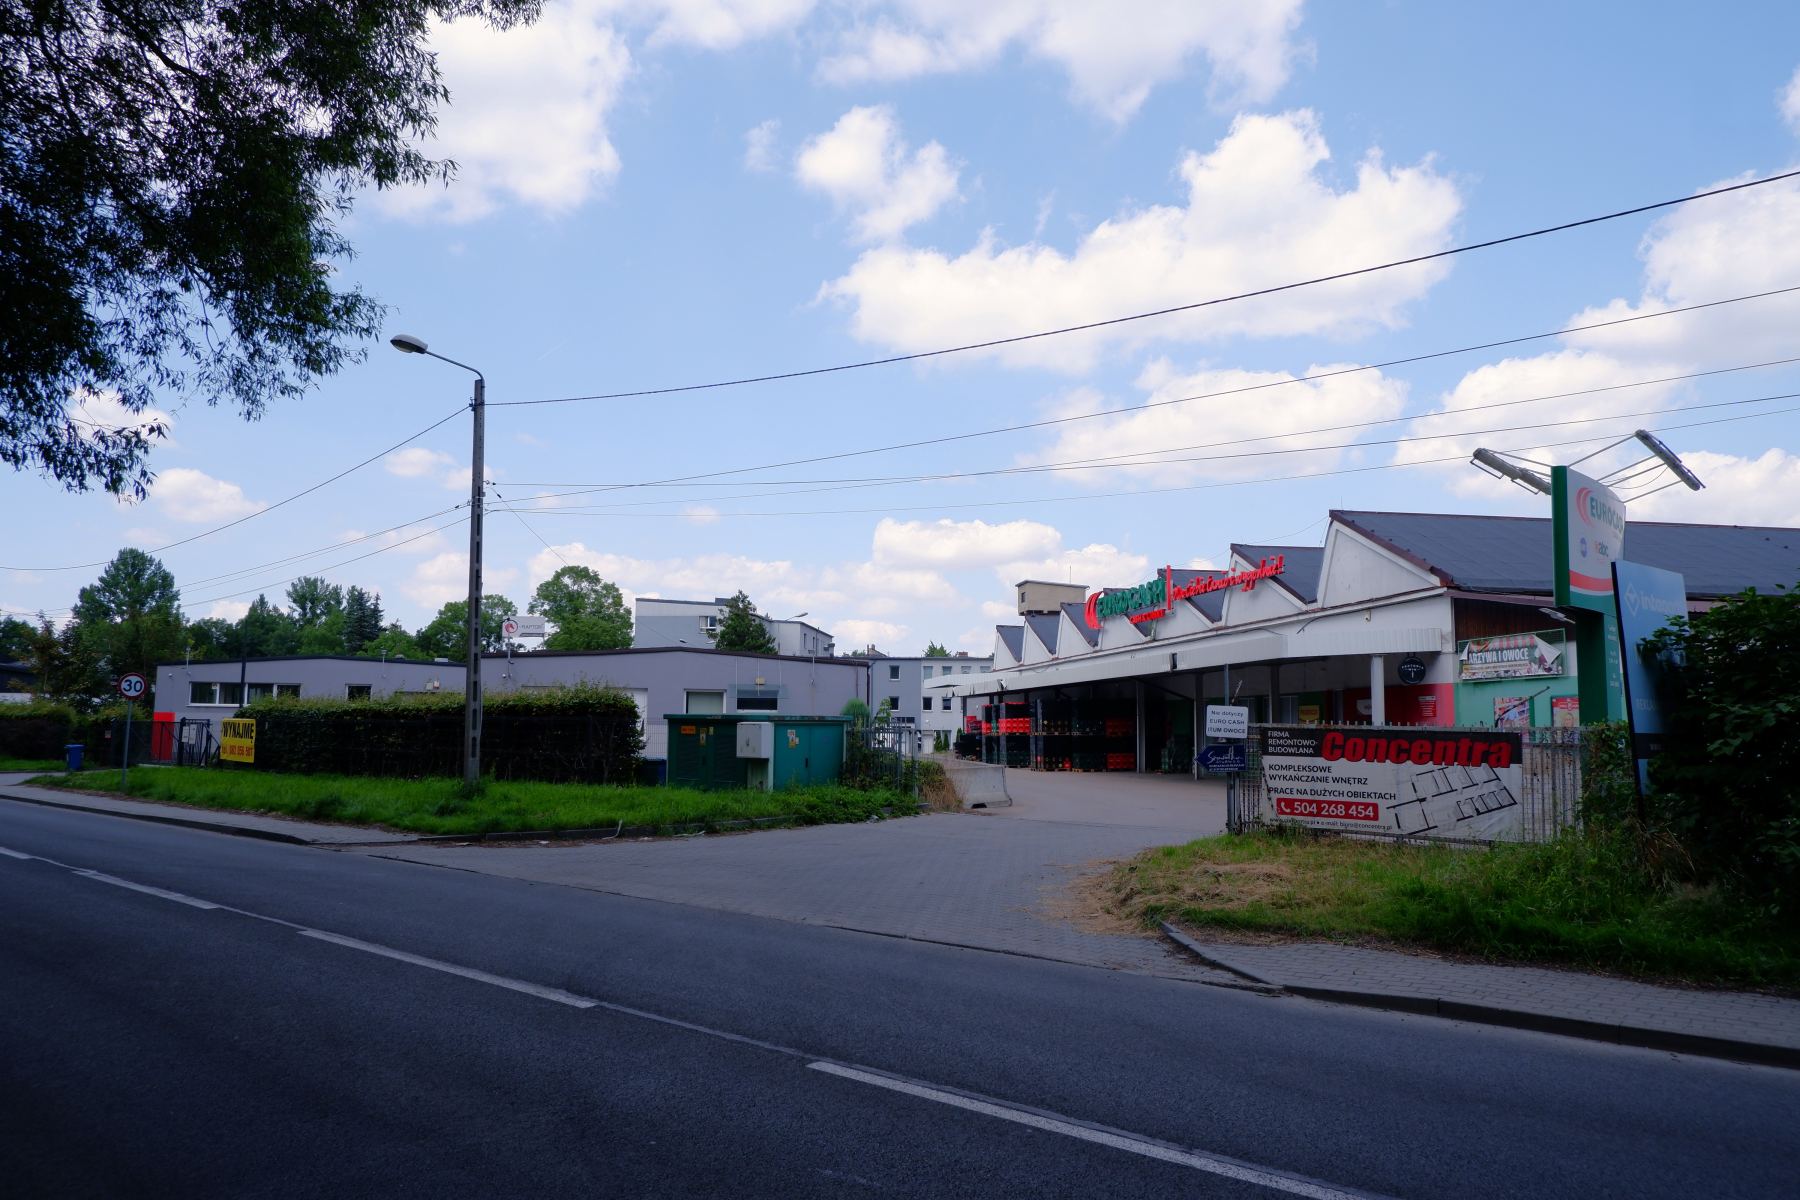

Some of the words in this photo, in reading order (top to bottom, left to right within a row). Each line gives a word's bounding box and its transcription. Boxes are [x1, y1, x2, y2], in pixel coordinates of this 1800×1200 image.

[1463, 649, 1497, 665] ARZYWA
[1502, 647, 1529, 661] OWOCE
[122, 679, 143, 693] 30
[1267, 730, 1290, 738] FIRMA
[1267, 738, 1319, 747] REMONTOWO-
[1321, 730, 1512, 768] Concentra
[1267, 747, 1315, 755] BUDOWLANA
[1268, 764, 1332, 774] KOMPLEKSOWE
[1268, 773, 1330, 784] WYKAŃCZANIE
[1331, 776, 1369, 786] WNĘTRZ
[1268, 787, 1294, 796] PRACE
[1296, 788, 1309, 796] NA
[1310, 787, 1345, 798] DUŻYCH
[1346, 790, 1397, 801] OBIEKTACH
[1293, 801, 1317, 814] 504
[1321, 803, 1346, 816] 268
[1348, 805, 1375, 818] 454
